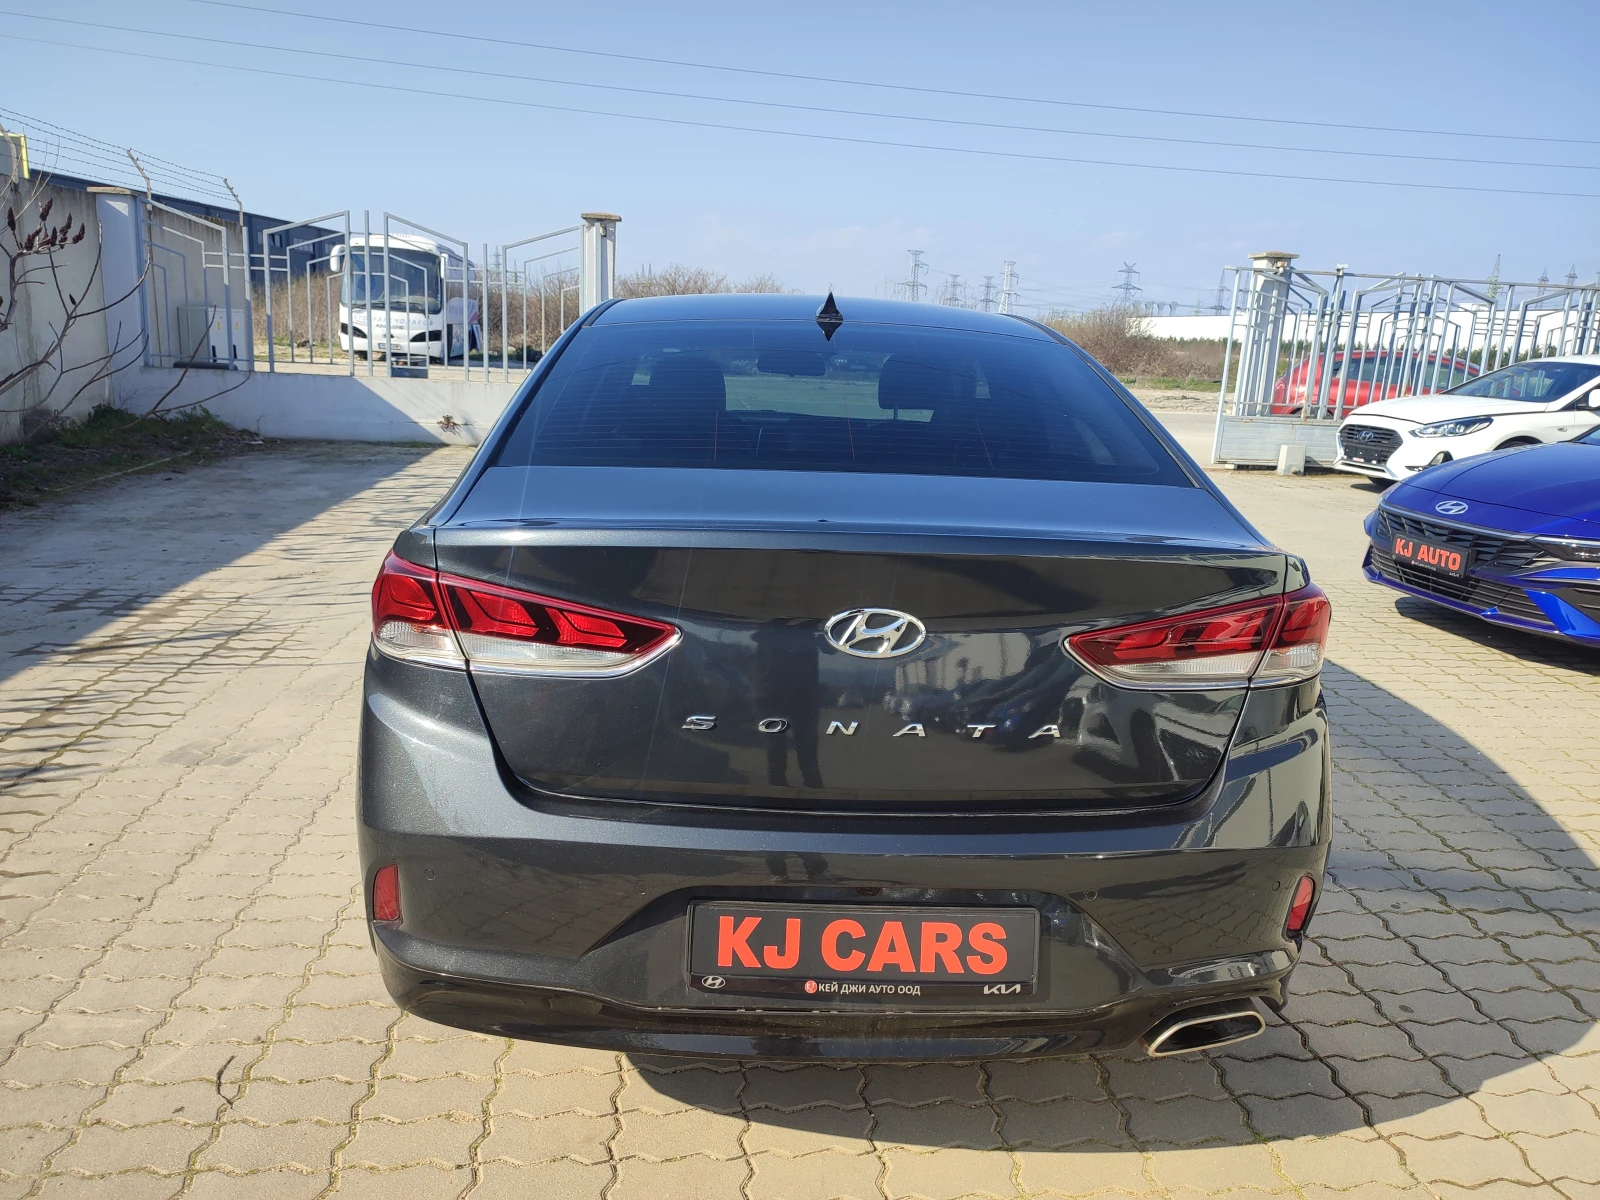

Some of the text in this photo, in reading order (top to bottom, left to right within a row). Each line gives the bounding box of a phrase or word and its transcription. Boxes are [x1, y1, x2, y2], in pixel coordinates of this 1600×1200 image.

[1395, 538, 1414, 558] KJ
[1417, 544, 1462, 571] AUTO
[682, 715, 1061, 738] SONATA
[717, 915, 1008, 975] KJ CARS
[818, 981, 921, 996] КЕЙ ДЖИ АУТО ООД
